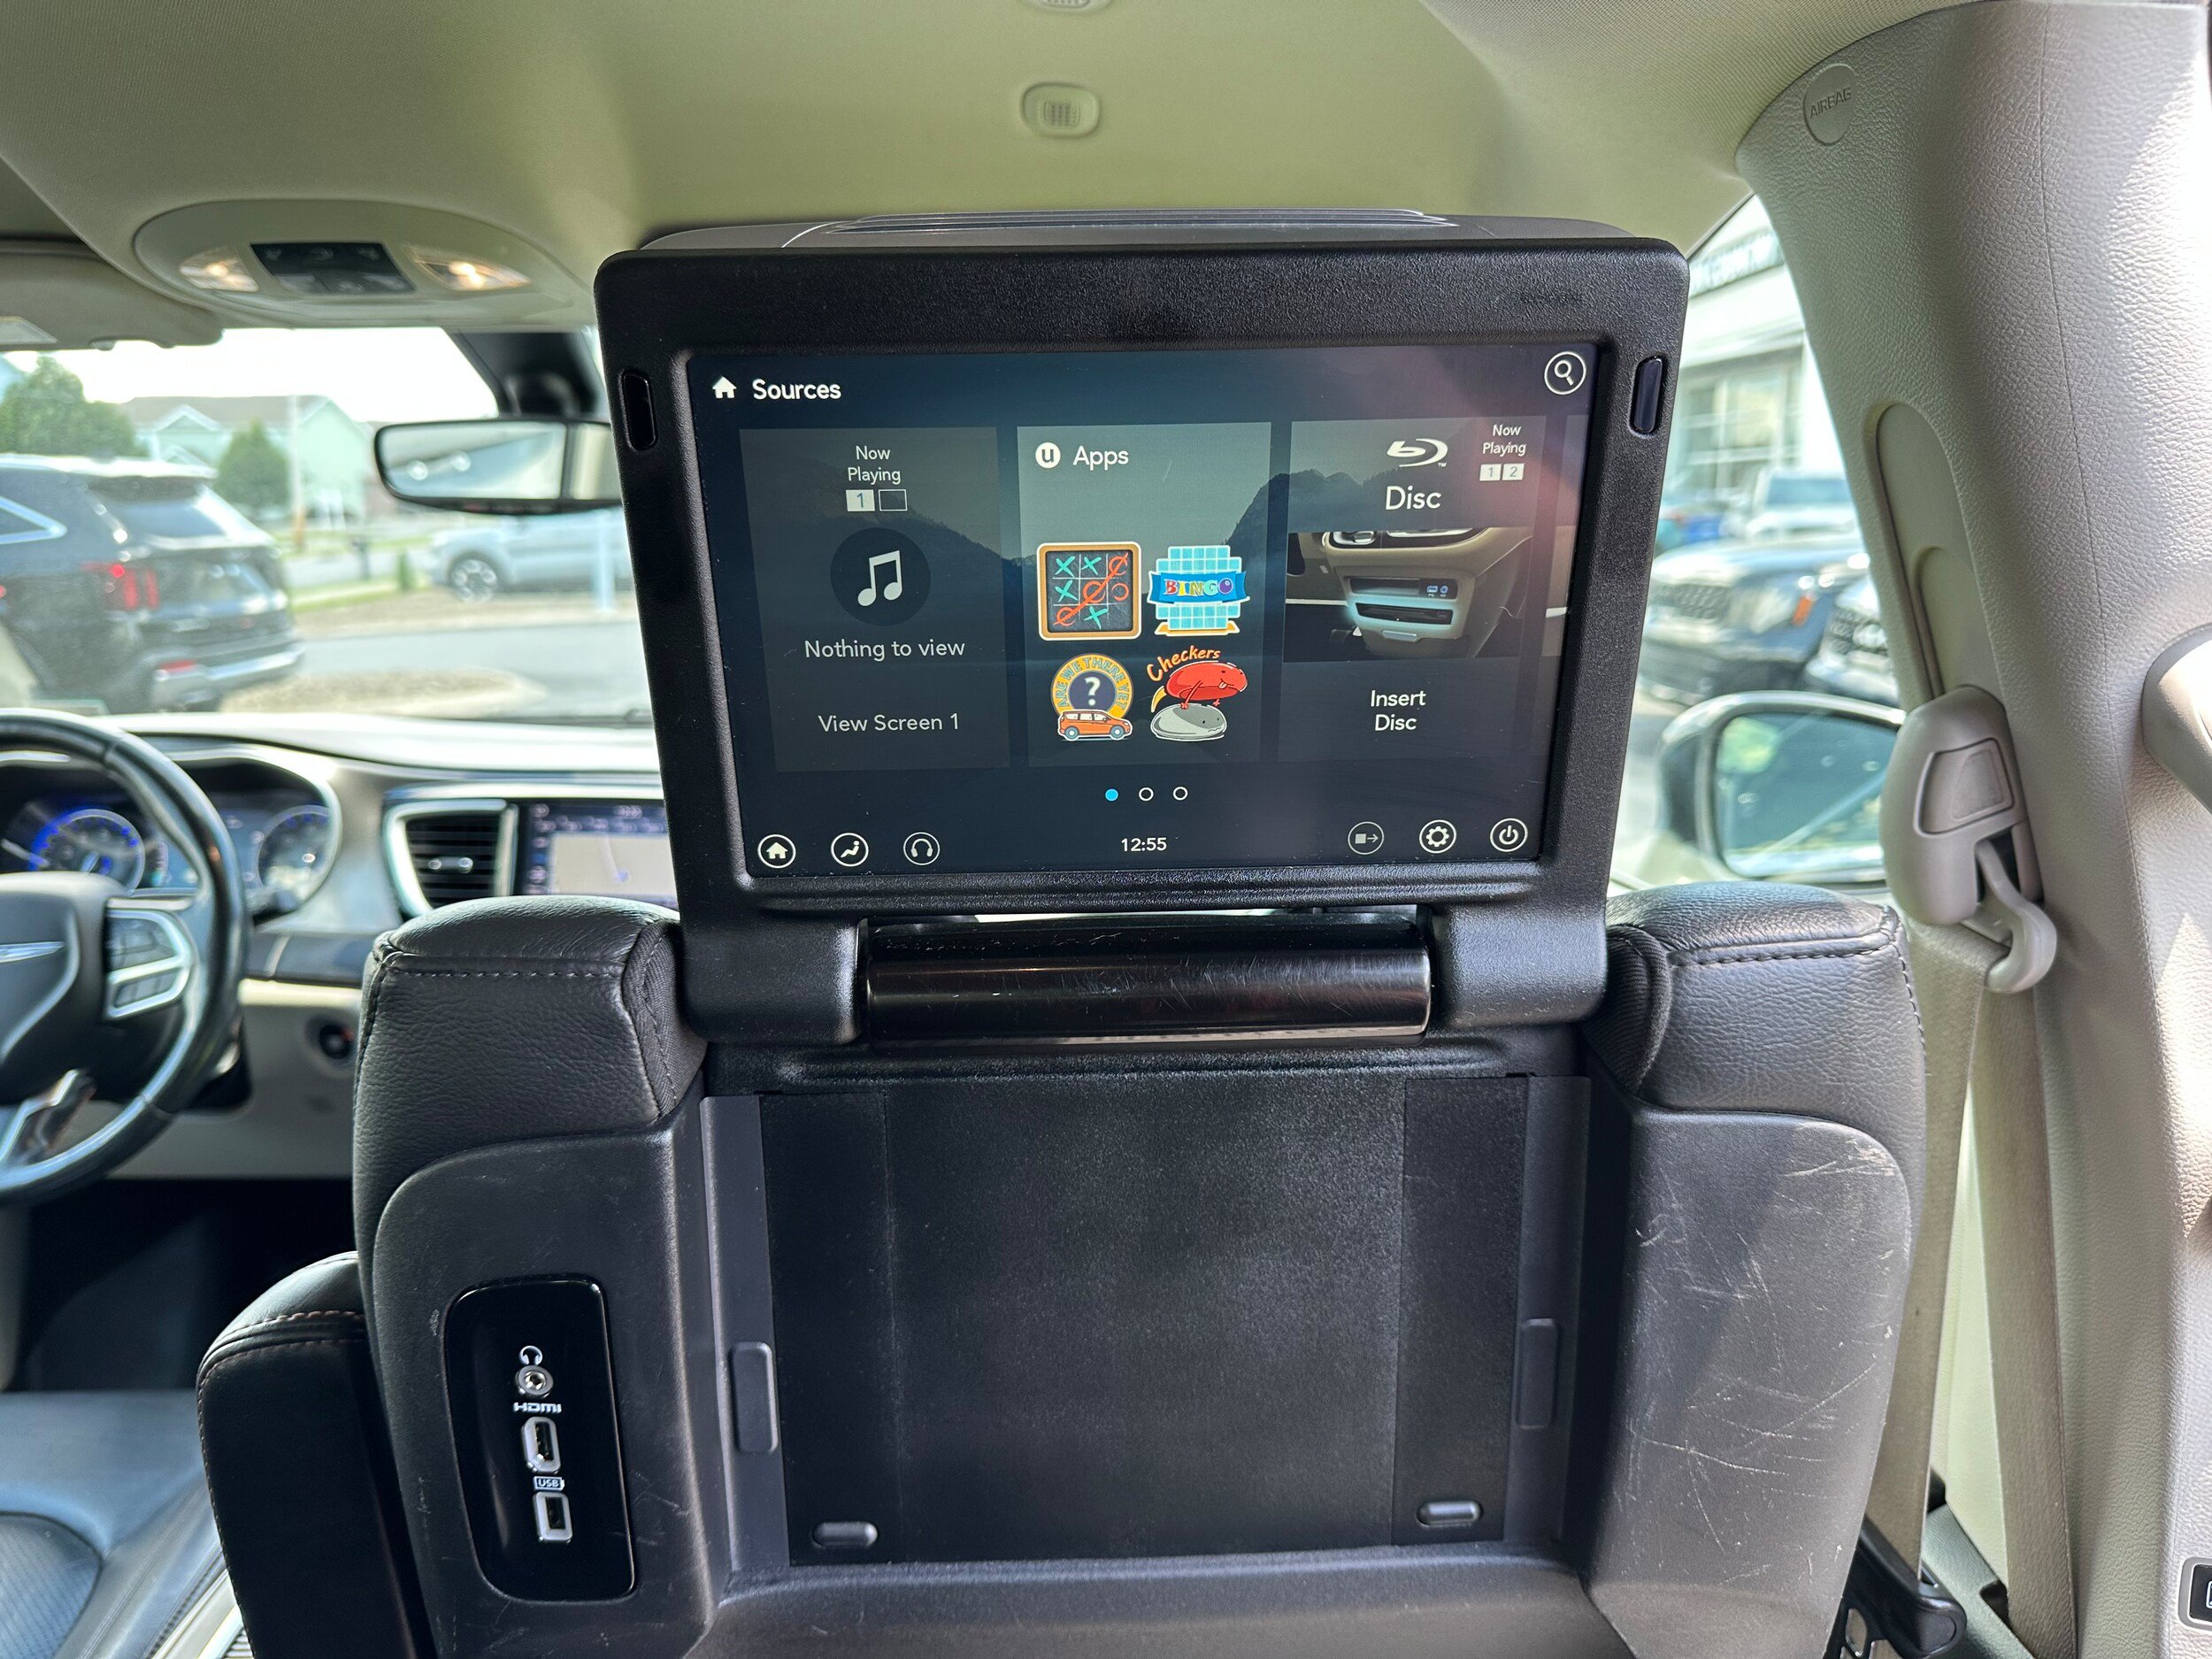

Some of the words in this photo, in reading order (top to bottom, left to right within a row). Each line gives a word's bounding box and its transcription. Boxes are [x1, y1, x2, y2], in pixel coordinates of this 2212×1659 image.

[1810, 87, 1852, 119] AIRBAG
[752, 379, 841, 400] Sources
[1492, 424, 1522, 437] Now
[856, 445, 891, 460] Now
[1072, 446, 1130, 471] Apps
[1482, 442, 1526, 457] Playing
[848, 465, 902, 485] Playing
[1386, 485, 1442, 511] Disc
[1163, 578, 1233, 596] BINGO
[803, 639, 886, 661] Nothing
[892, 641, 912, 657] to
[918, 639, 966, 657] view
[1062, 661, 1081, 680] WE
[1083, 657, 1125, 682] THERE
[1147, 645, 1220, 681] Checkers
[1056, 680, 1070, 708] ARE
[1115, 683, 1130, 710] YET
[1371, 689, 1426, 708] Insert
[818, 714, 869, 733] View
[873, 713, 943, 732] Screen
[949, 712, 959, 730] 1
[1374, 713, 1417, 732] Disc
[1121, 837, 1168, 852] 12:55
[513, 1402, 562, 1414] HDMI
[538, 1479, 559, 1487] USB
